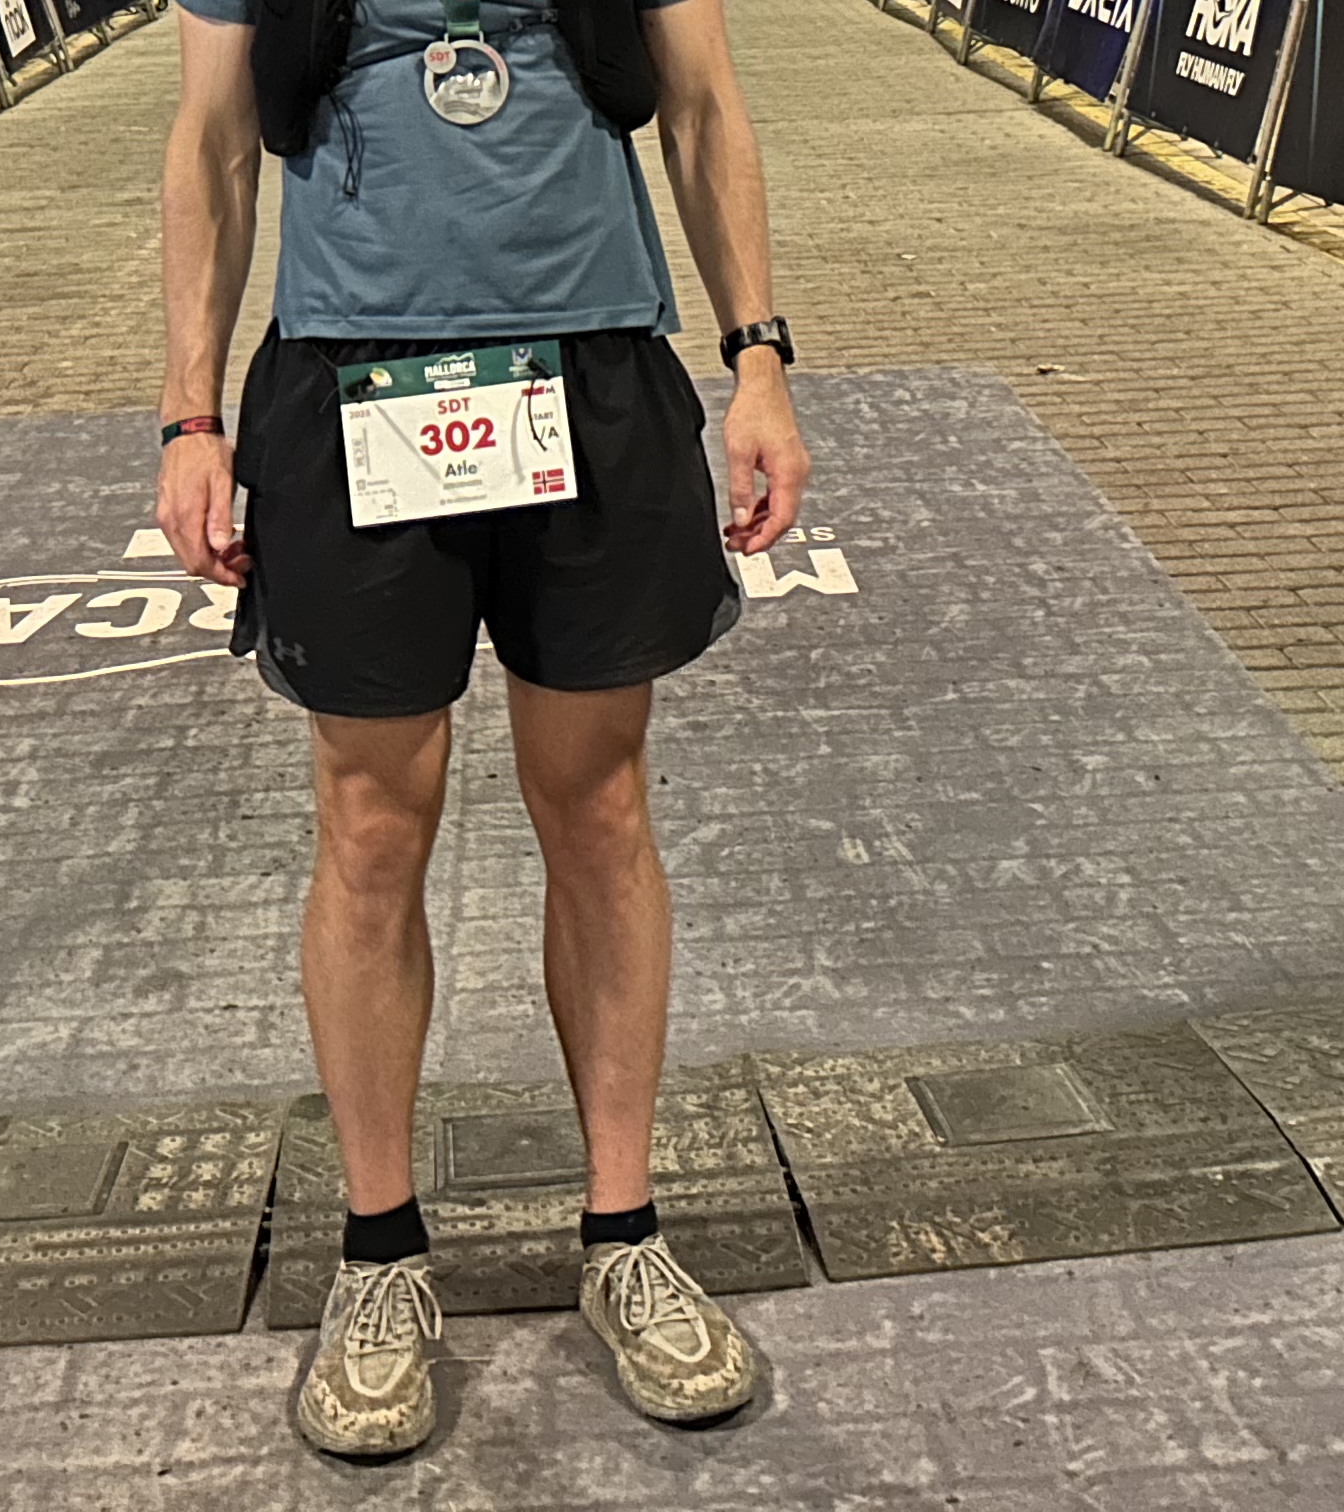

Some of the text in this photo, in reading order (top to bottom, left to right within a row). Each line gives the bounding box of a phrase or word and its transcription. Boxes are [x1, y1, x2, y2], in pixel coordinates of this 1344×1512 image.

[429, 51, 450, 62] SDT
[437, 396, 472, 415] SDT
[419, 416, 497, 457] 302
[444, 459, 478, 478] Atle
